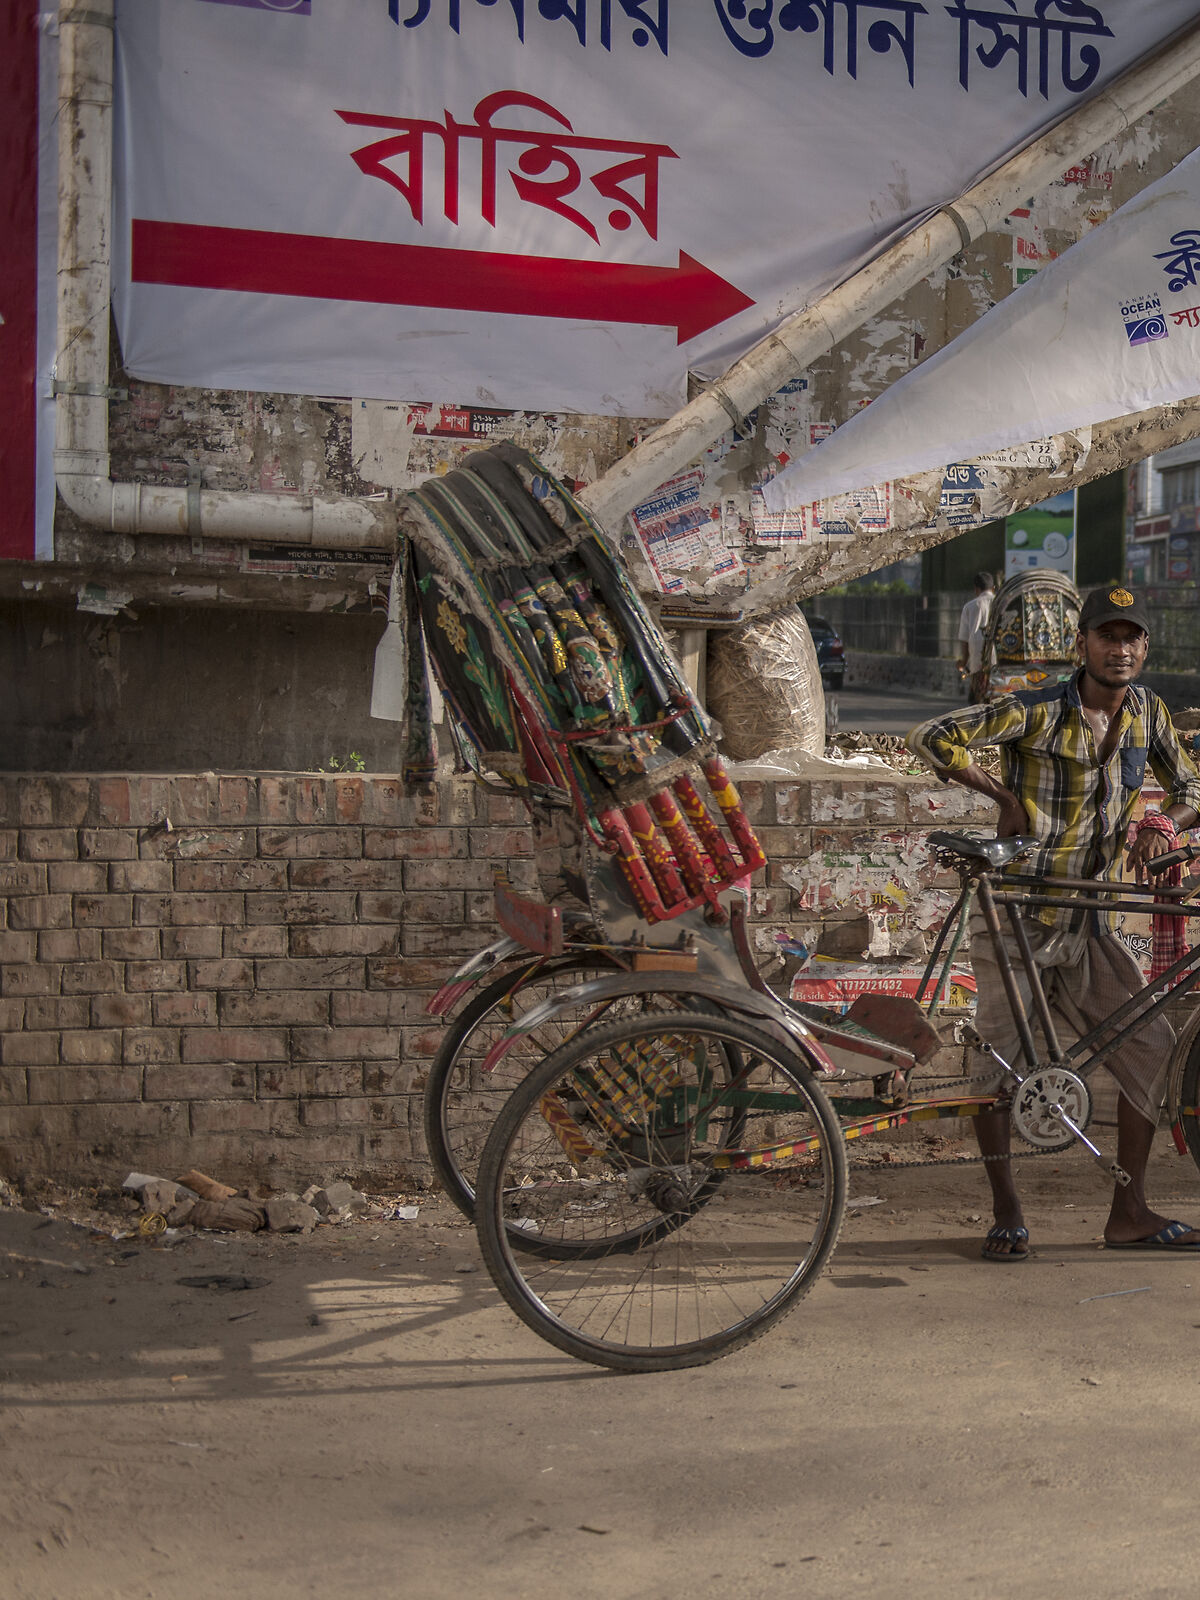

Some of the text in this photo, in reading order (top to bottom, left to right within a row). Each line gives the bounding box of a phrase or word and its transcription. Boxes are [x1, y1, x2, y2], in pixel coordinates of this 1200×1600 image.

[943, 0, 1116, 101] সিটি
[334, 89, 681, 246] বাহির
[1117, 291, 1159, 307] SANMAR
[1120, 298, 1162, 317] OCEAN
[1122, 307, 1162, 324] CITY
